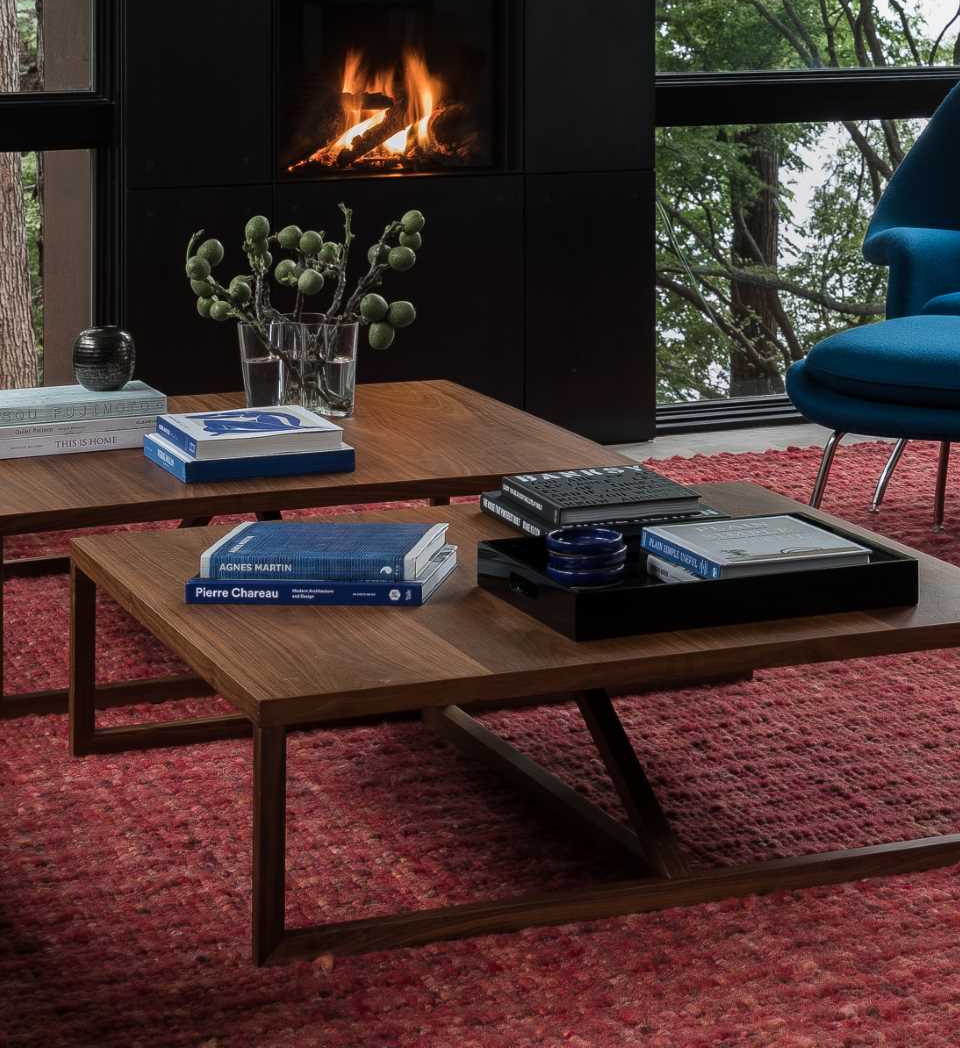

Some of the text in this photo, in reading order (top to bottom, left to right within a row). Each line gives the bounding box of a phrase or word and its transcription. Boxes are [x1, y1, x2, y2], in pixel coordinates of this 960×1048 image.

[55, 438, 79, 449] THIS
[79, 438, 89, 448] IS
[90, 435, 119, 447] HOME
[514, 463, 642, 483] BANKSY
[649, 537, 664, 551] PLAIN
[218, 563, 292, 572] AGNES MARTIN
[195, 587, 279, 599] Pierre Chareau
